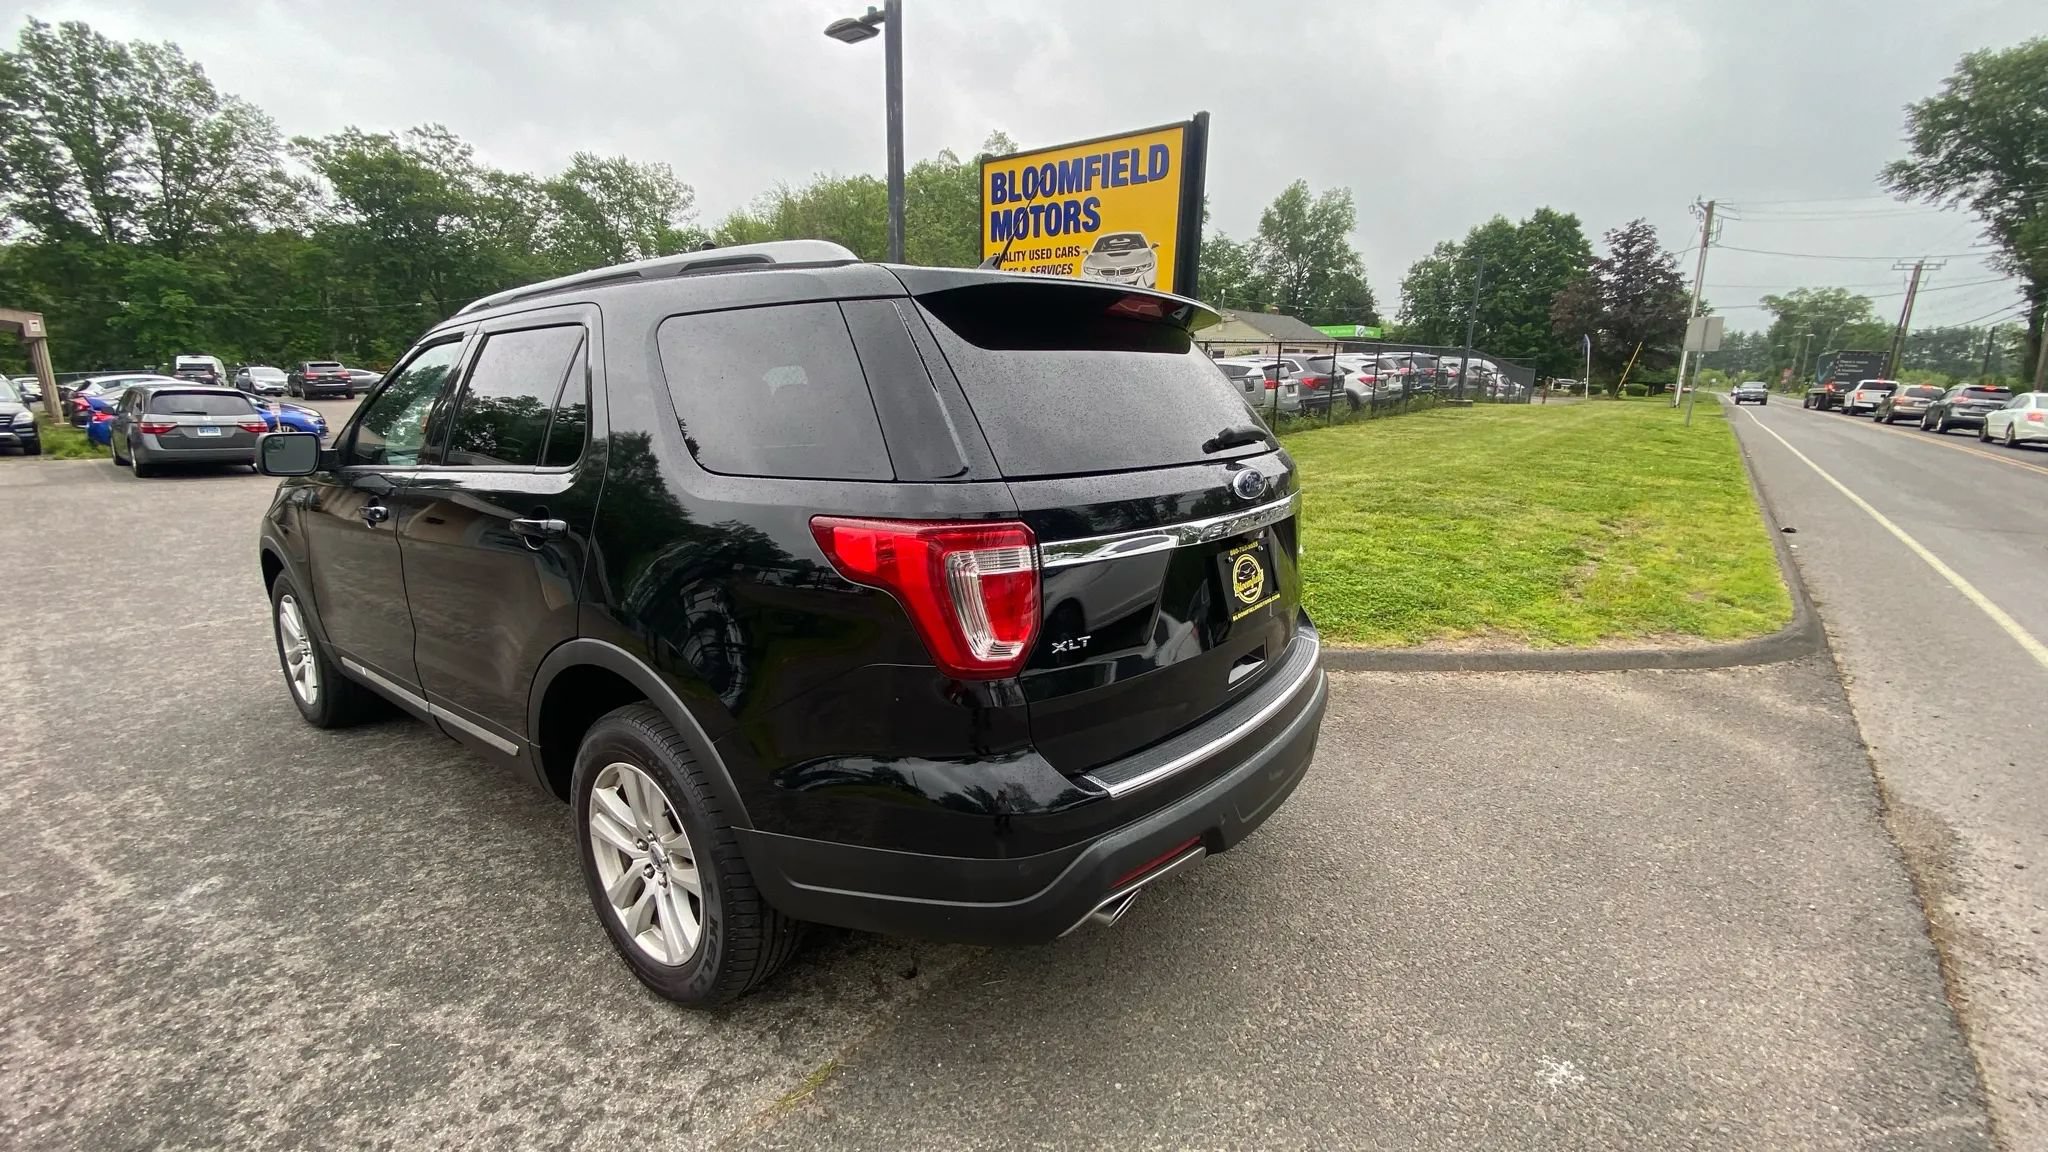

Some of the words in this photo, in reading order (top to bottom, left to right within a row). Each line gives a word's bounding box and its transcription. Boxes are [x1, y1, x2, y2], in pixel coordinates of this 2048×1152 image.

[991, 143, 1170, 205] BLOOMFIELD
[990, 196, 1101, 243] MOTORS
[1029, 248, 1052, 260] USED
[1055, 245, 1081, 258] CARS
[1051, 635, 1092, 654] XLT
